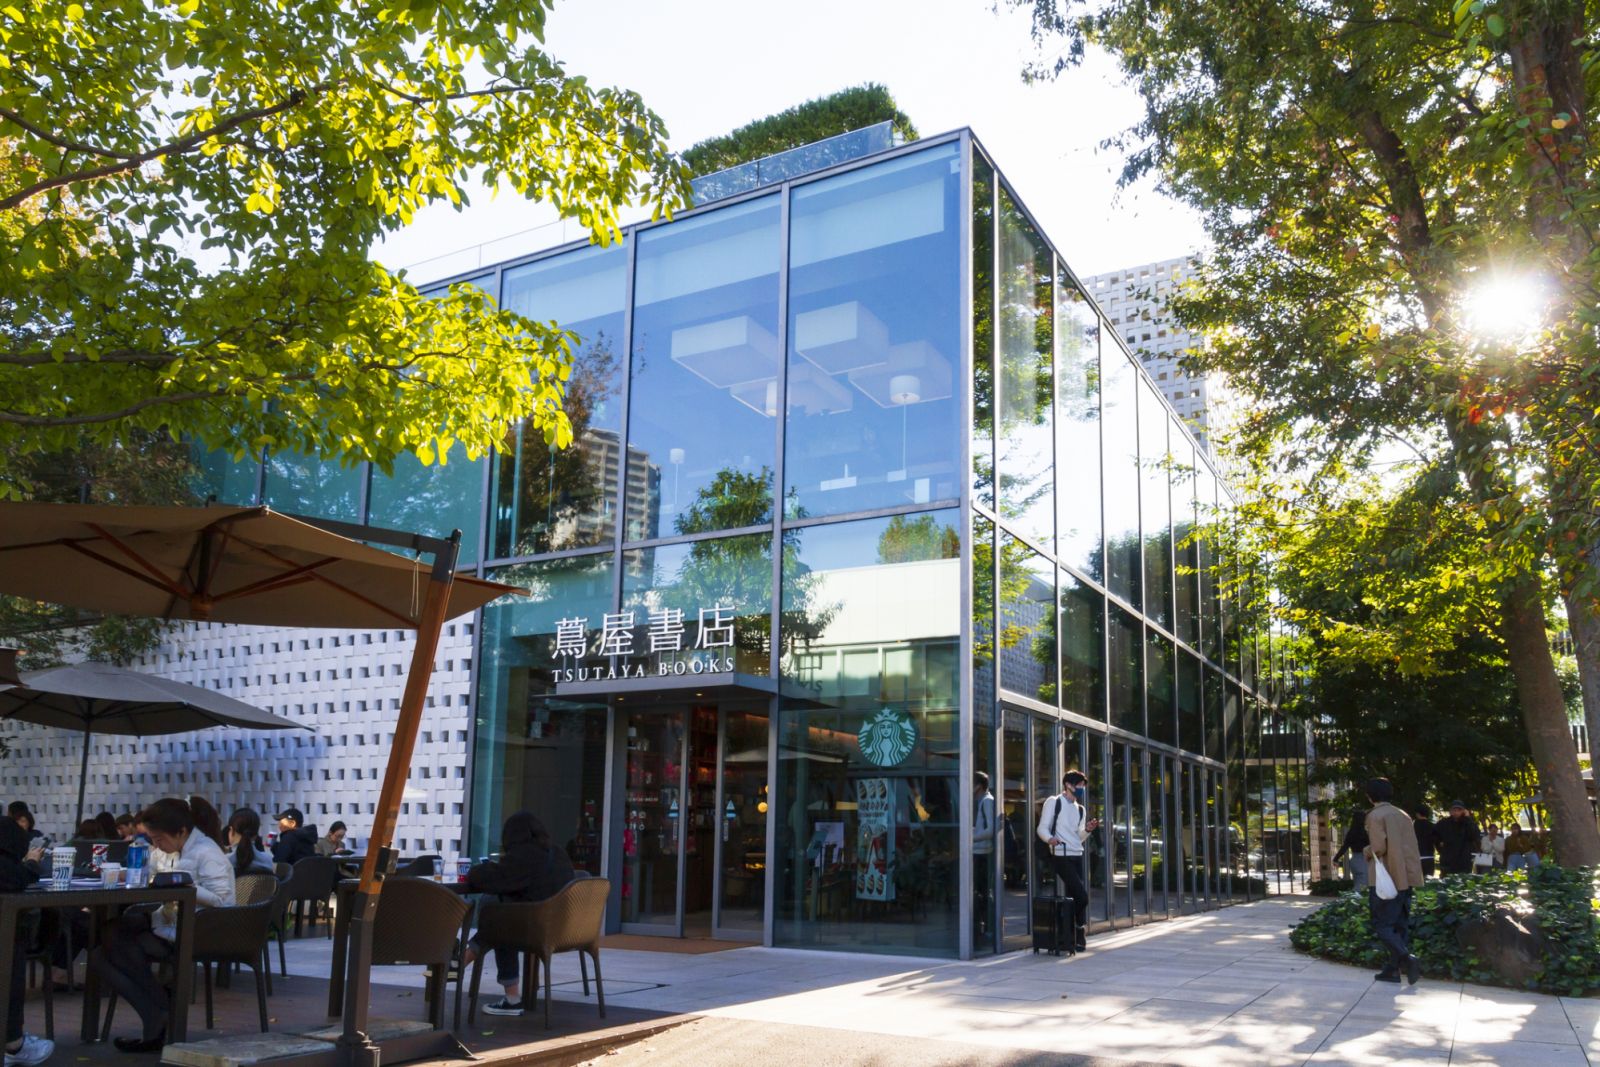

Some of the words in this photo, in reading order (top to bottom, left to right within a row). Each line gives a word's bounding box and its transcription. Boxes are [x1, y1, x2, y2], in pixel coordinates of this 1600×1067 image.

[551, 602, 736, 659] 蔦屋書店
[551, 664, 645, 683] TSUTAYA
[658, 657, 735, 677] BOOKS
